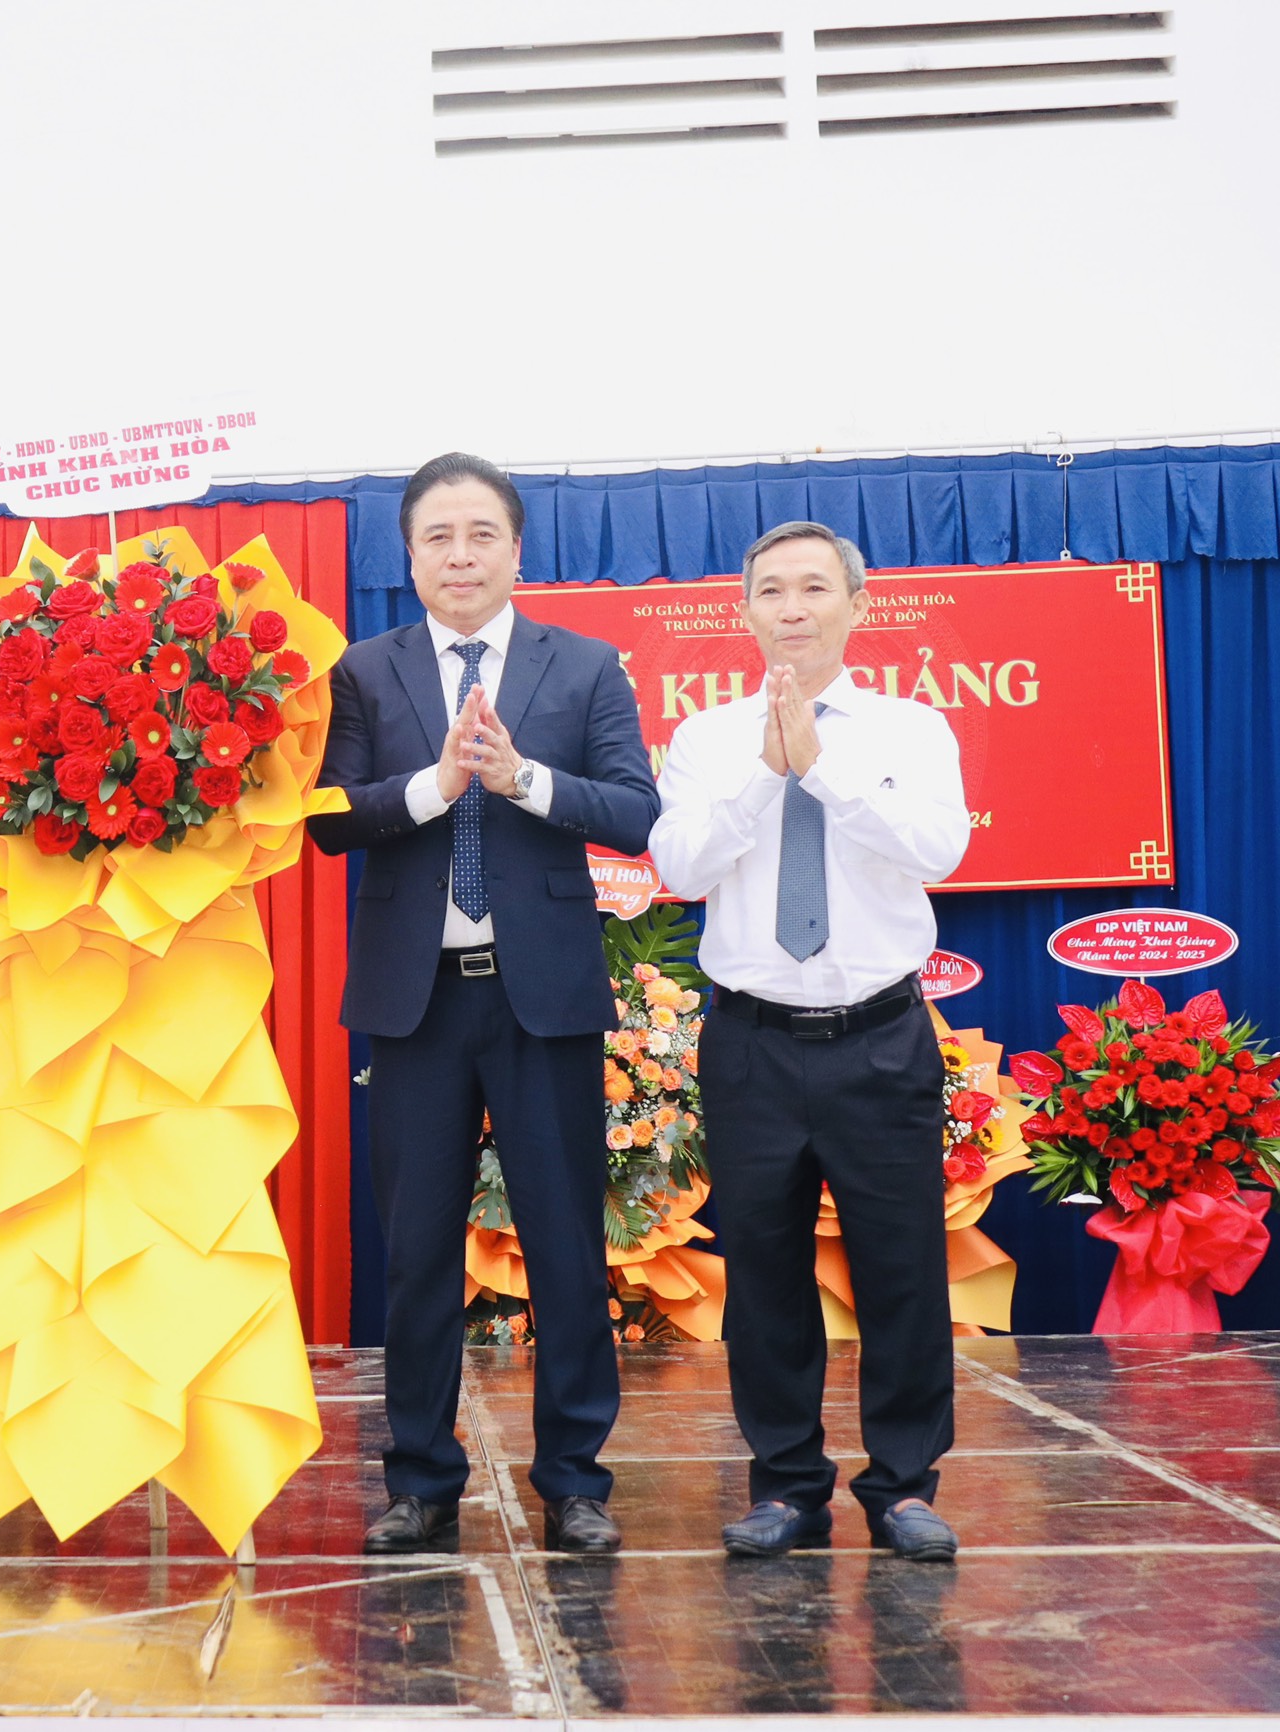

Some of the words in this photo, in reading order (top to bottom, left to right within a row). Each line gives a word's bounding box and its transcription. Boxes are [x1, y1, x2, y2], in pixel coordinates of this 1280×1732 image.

[69, 431, 109, 450] UBND
[122, 418, 204, 443] UBMTTQVN
[58, 446, 160, 473] KHÁNH
[170, 436, 231, 457] HÒA
[25, 475, 100, 500] CHÚC
[110, 465, 190, 489] MỪNG
[655, 601, 694, 616] GIÁO
[698, 603, 728, 616] DỤC
[923, 591, 956, 605] HÒA
[895, 608, 927, 622] ĐÔN
[847, 646, 1040, 708] GIẢNG
[616, 865, 654, 884] HOÀ
[1095, 922, 1119, 934] IDP
[1122, 919, 1151, 935] VIỆT
[1154, 921, 1188, 933] NAM
[1066, 937, 1097, 948] Chúc
[1099, 936, 1137, 949] Mừng
[1139, 935, 1173, 946] Khai
[1175, 935, 1217, 948] Giảng
[1077, 951, 1111, 961] Năm
[1113, 950, 1135, 962] học
[1138, 950, 1168, 961] 2024
[1176, 950, 1206, 960] 2025
[940, 957, 963, 975] ĐÔN
